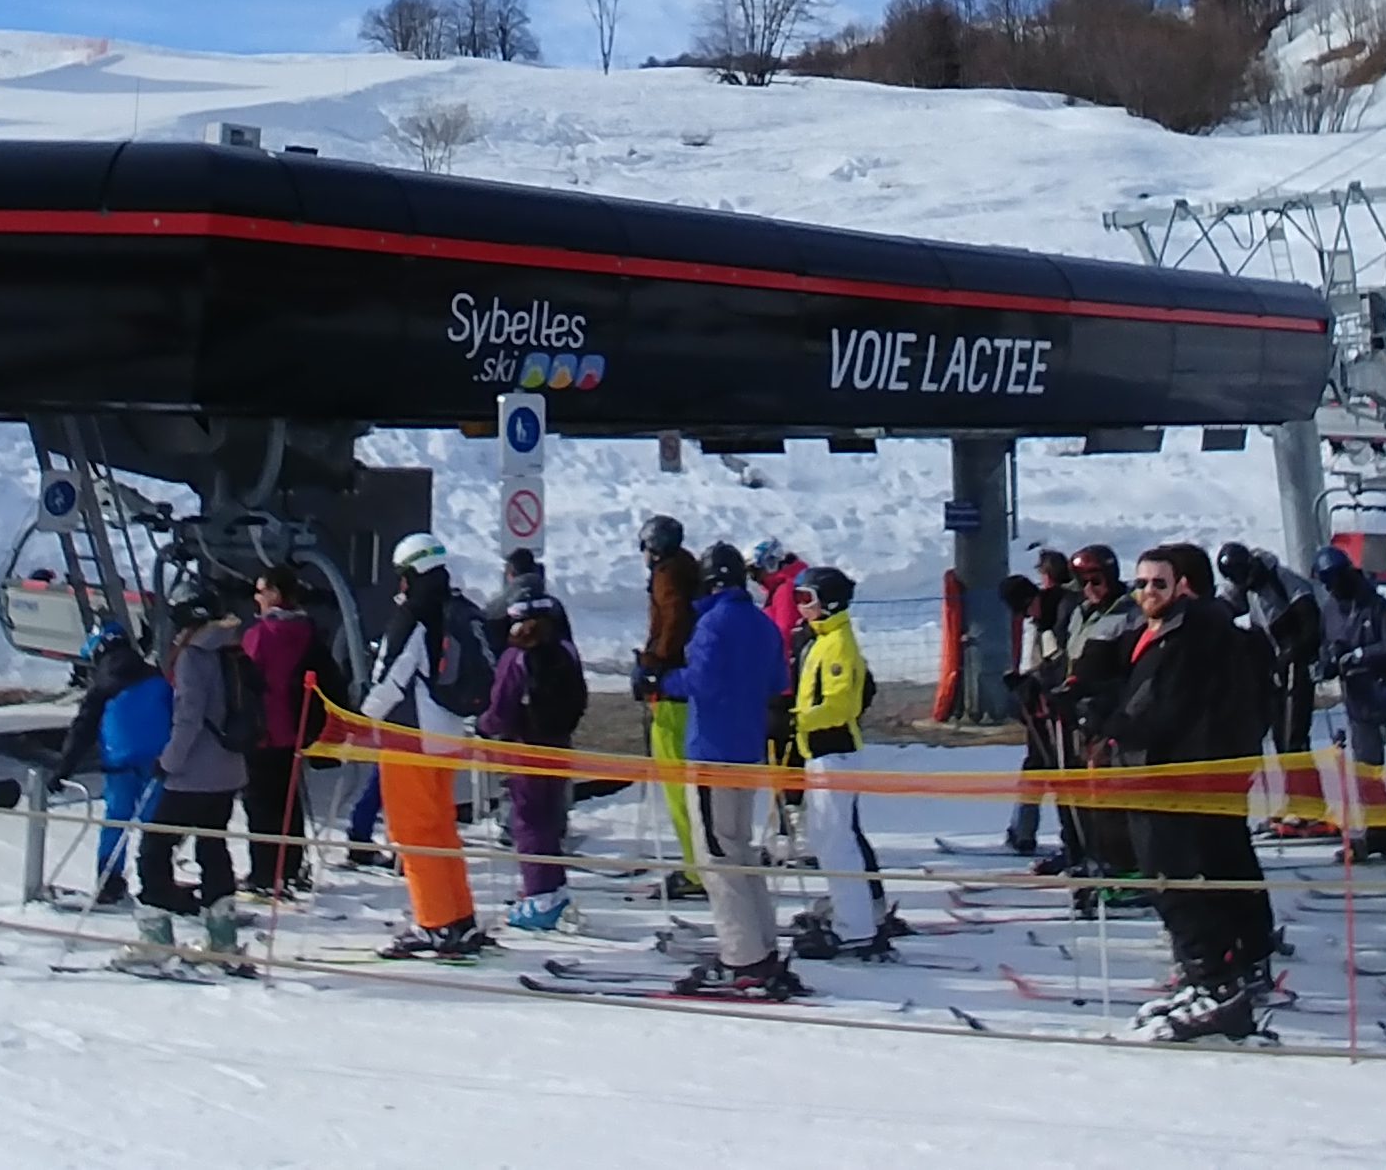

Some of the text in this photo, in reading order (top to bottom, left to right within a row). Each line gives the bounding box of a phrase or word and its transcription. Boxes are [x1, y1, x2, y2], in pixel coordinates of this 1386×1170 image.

[447, 292, 586, 359] Sybelles
[830, 328, 1052, 394] VOIE LACTEE
